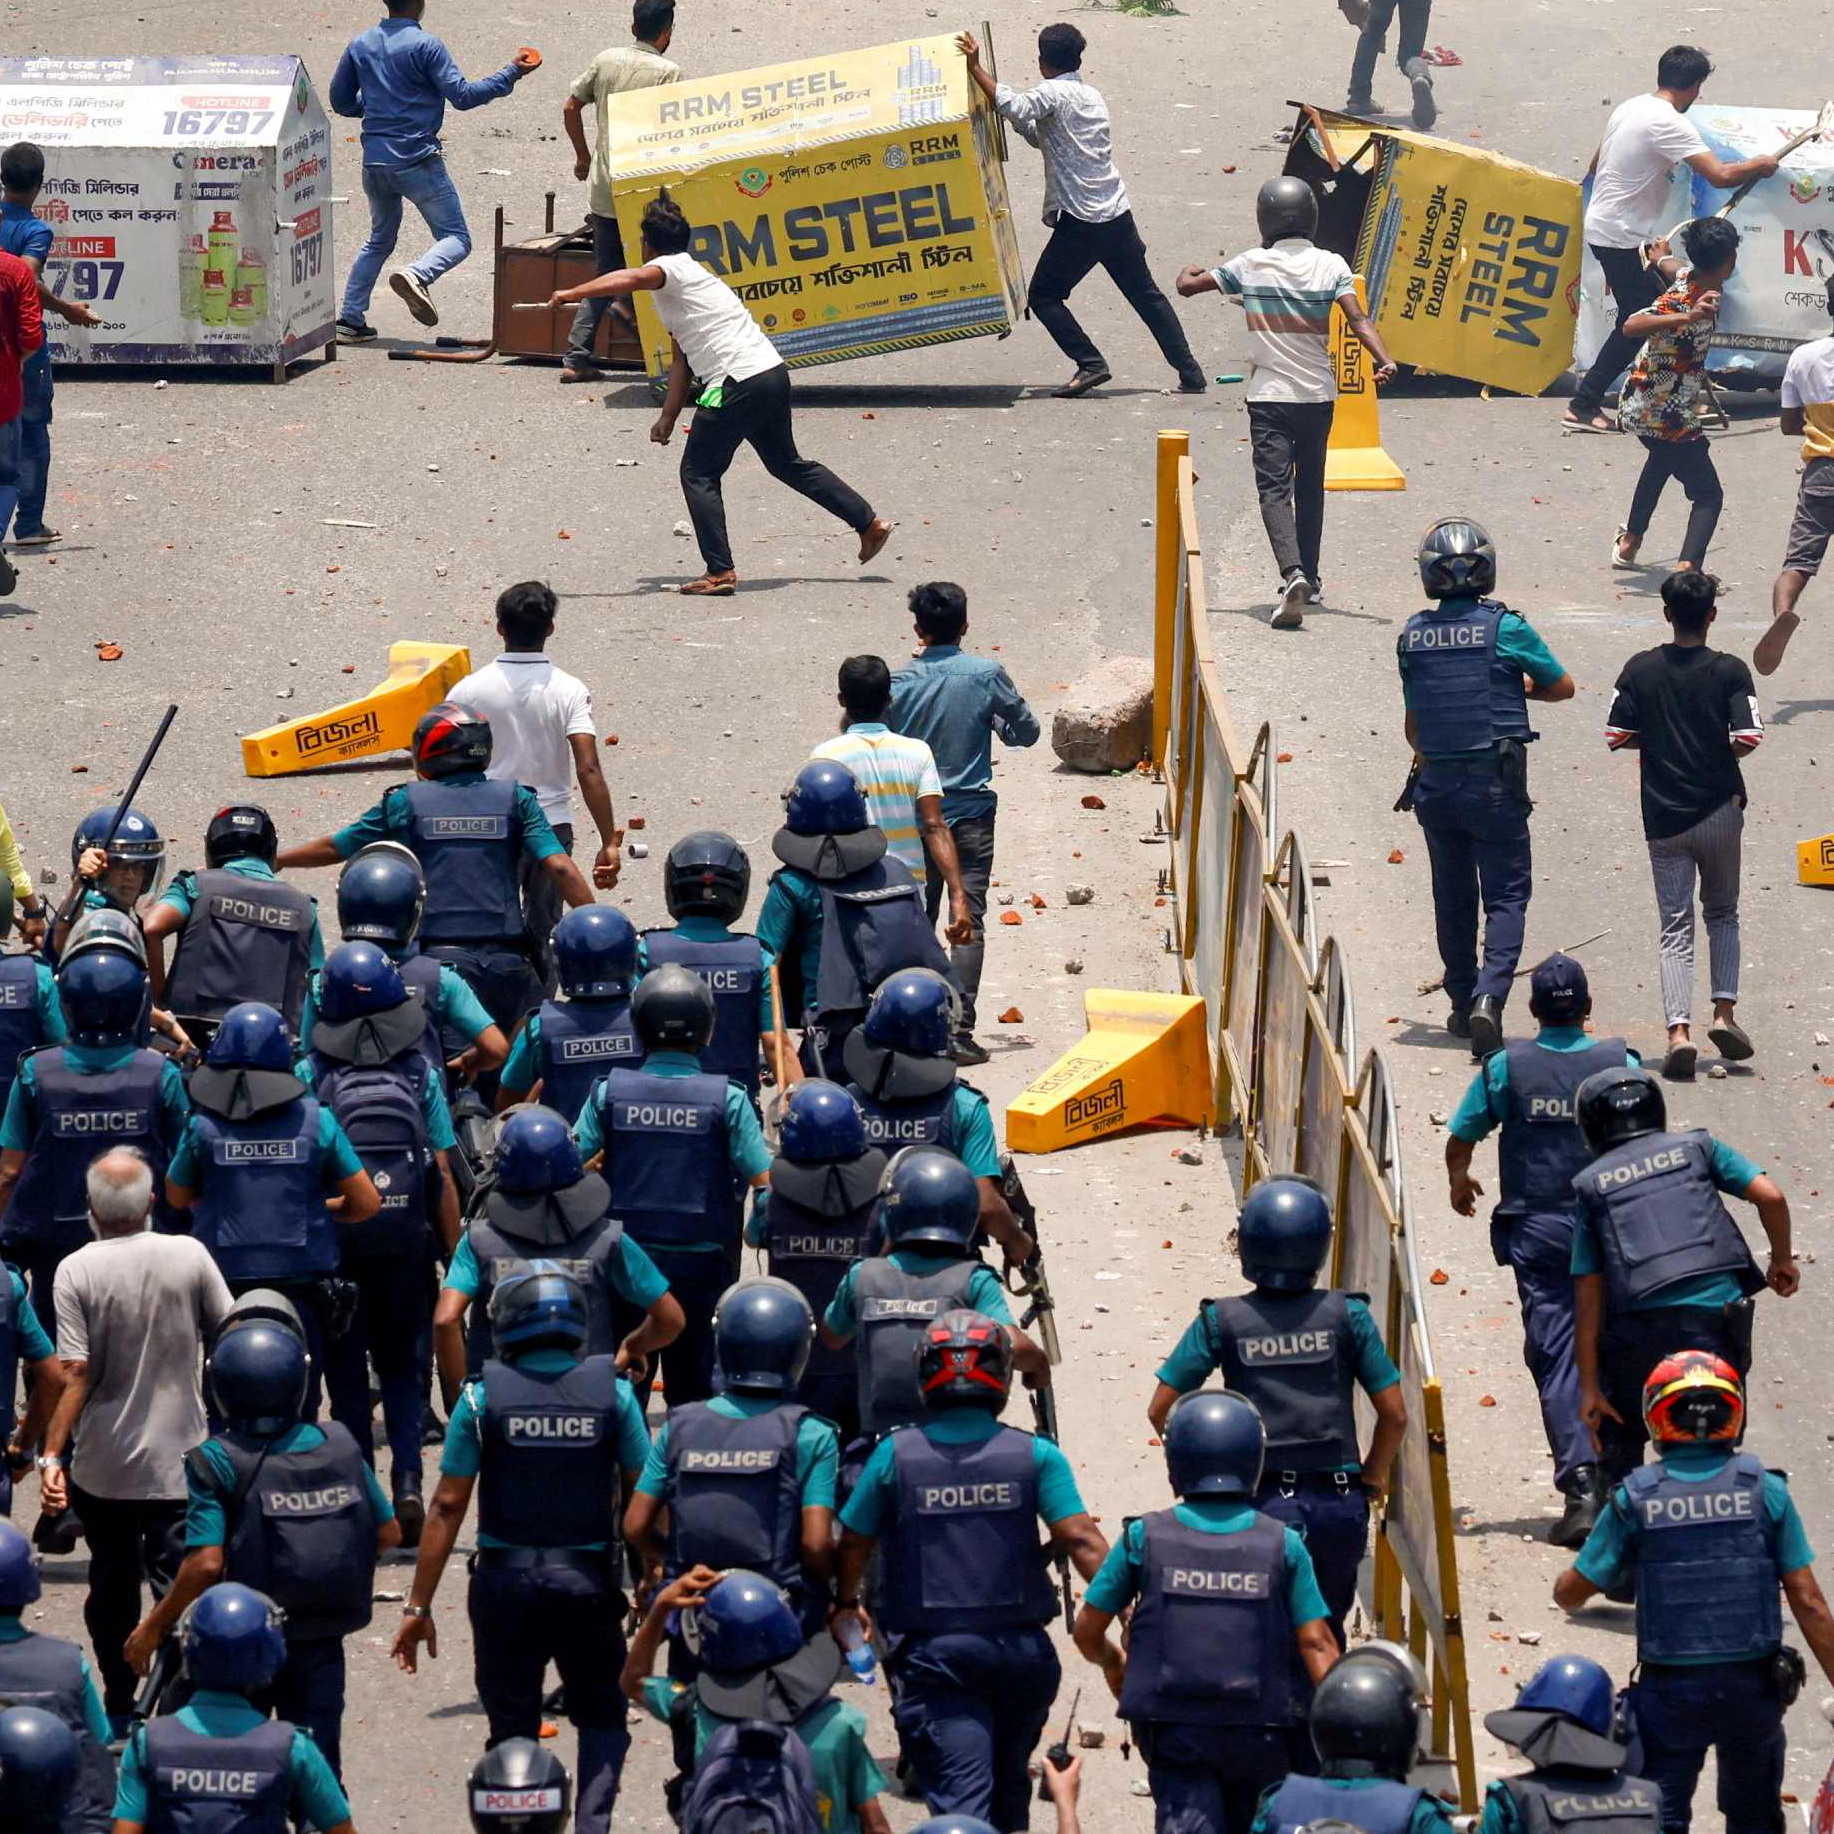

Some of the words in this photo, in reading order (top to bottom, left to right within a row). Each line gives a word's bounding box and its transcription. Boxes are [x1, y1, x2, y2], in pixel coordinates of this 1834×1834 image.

[660, 91, 734, 124] RRM
[742, 70, 848, 110] STEEL
[162, 110, 275, 136] 16797
[910, 133, 959, 155] RRM
[778, 164, 809, 185] পুলিশ
[814, 159, 837, 176] চেক
[840, 152, 872, 172] পোস্ট
[689, 214, 777, 277] RM
[784, 182, 976, 262] STEEL
[290, 232, 323, 286] 16797
[810, 251, 912, 288] শক্তিশালী
[1460, 210, 1515, 324] STEEL
[1494, 214, 1570, 348] RRM
[1409, 626, 1485, 650] POLICE
[438, 820, 491, 835] POLICE
[221, 899, 290, 926] POLICE
[569, 1039, 628, 1057] POLICE
[61, 1112, 139, 1133] POLICE
[626, 1107, 697, 1128] POLICE
[863, 1118, 925, 1141] POLICE
[233, 1142, 289, 1158] POLICE
[1598, 1149, 1685, 1190] POLICE
[789, 1235, 857, 1256] POLICE
[883, 1300, 931, 1316] POLICE
[1246, 1332, 1331, 1360] POLICE
[508, 1415, 595, 1439] POLICE
[687, 1450, 773, 1470] POLICE
[271, 1486, 351, 1512] POLICE
[925, 1482, 1012, 1508] POLICE
[1646, 1491, 1752, 1521] POLICE
[1172, 1570, 1259, 1594] POLICE
[173, 1768, 257, 1793] POLICE
[485, 1791, 548, 1811] POLICE
